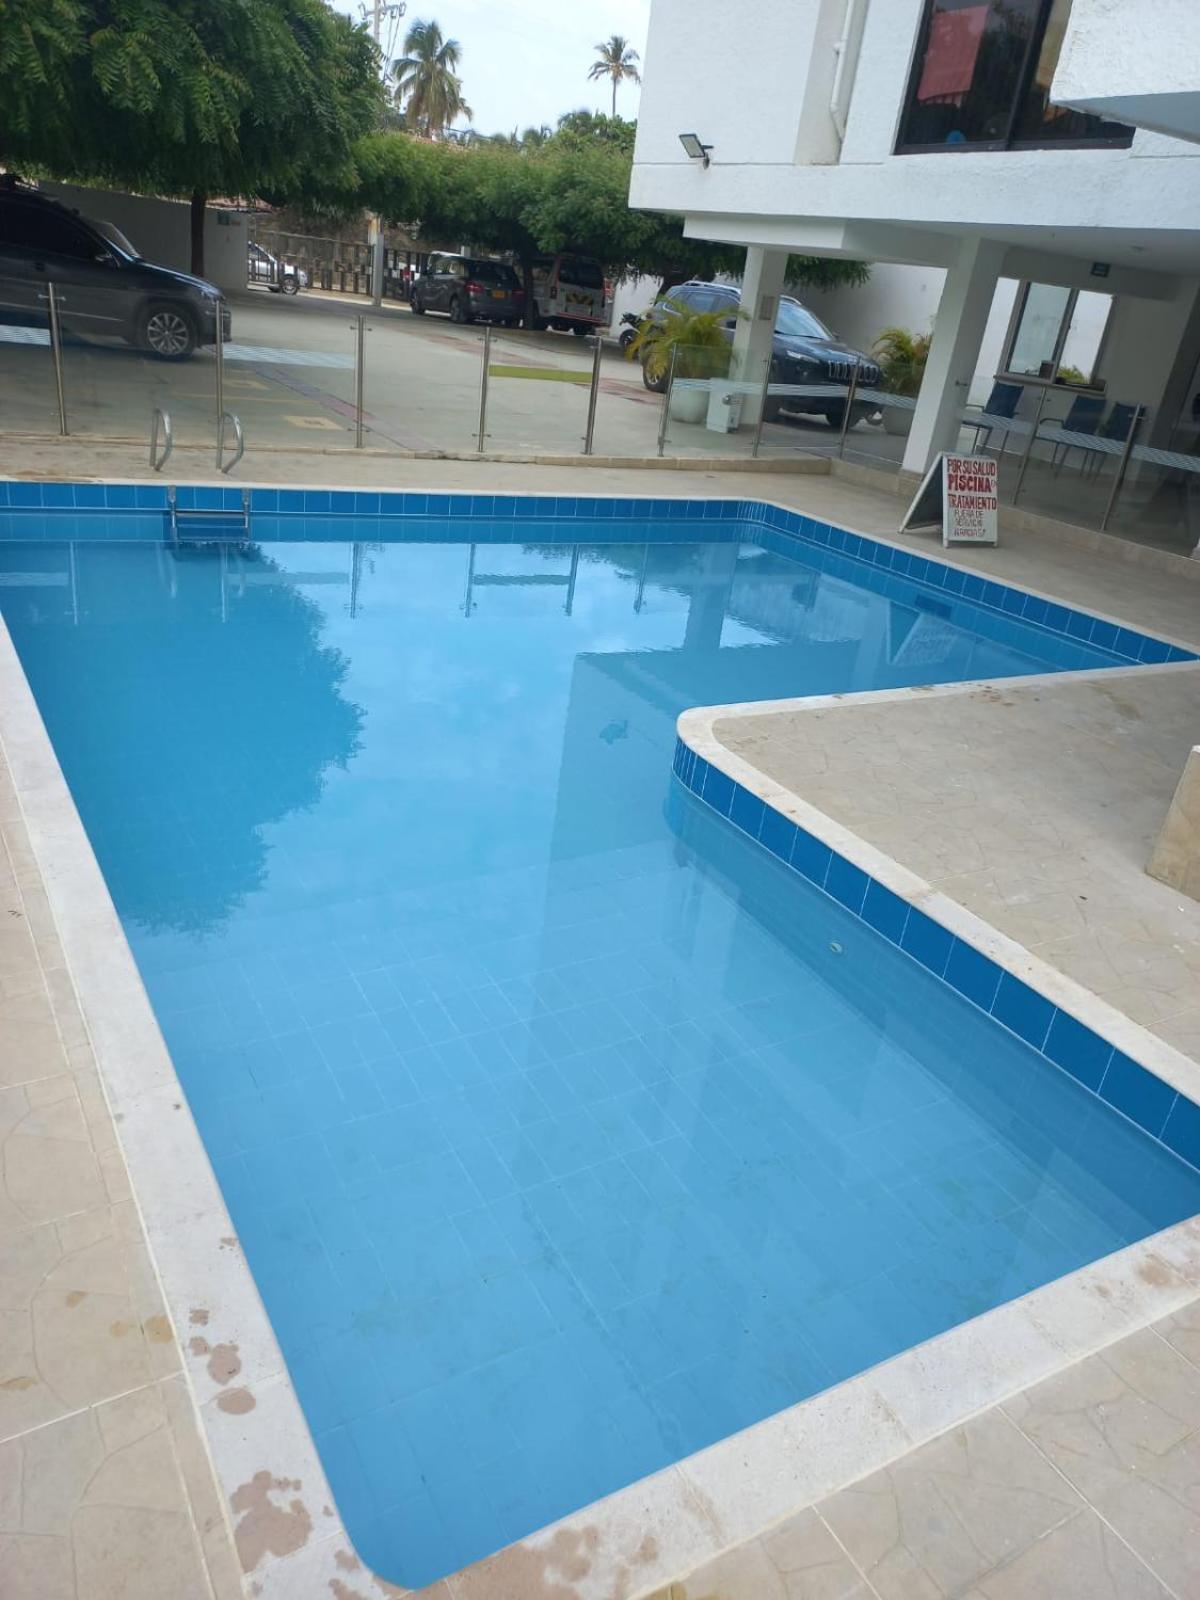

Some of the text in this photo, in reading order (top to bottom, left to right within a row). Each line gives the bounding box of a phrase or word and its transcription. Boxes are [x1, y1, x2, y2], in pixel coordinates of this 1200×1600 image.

[947, 458, 996, 477] POR SU SALUD
[948, 474, 992, 493] PISCINA
[948, 494, 997, 510] TRATAMIENTO
